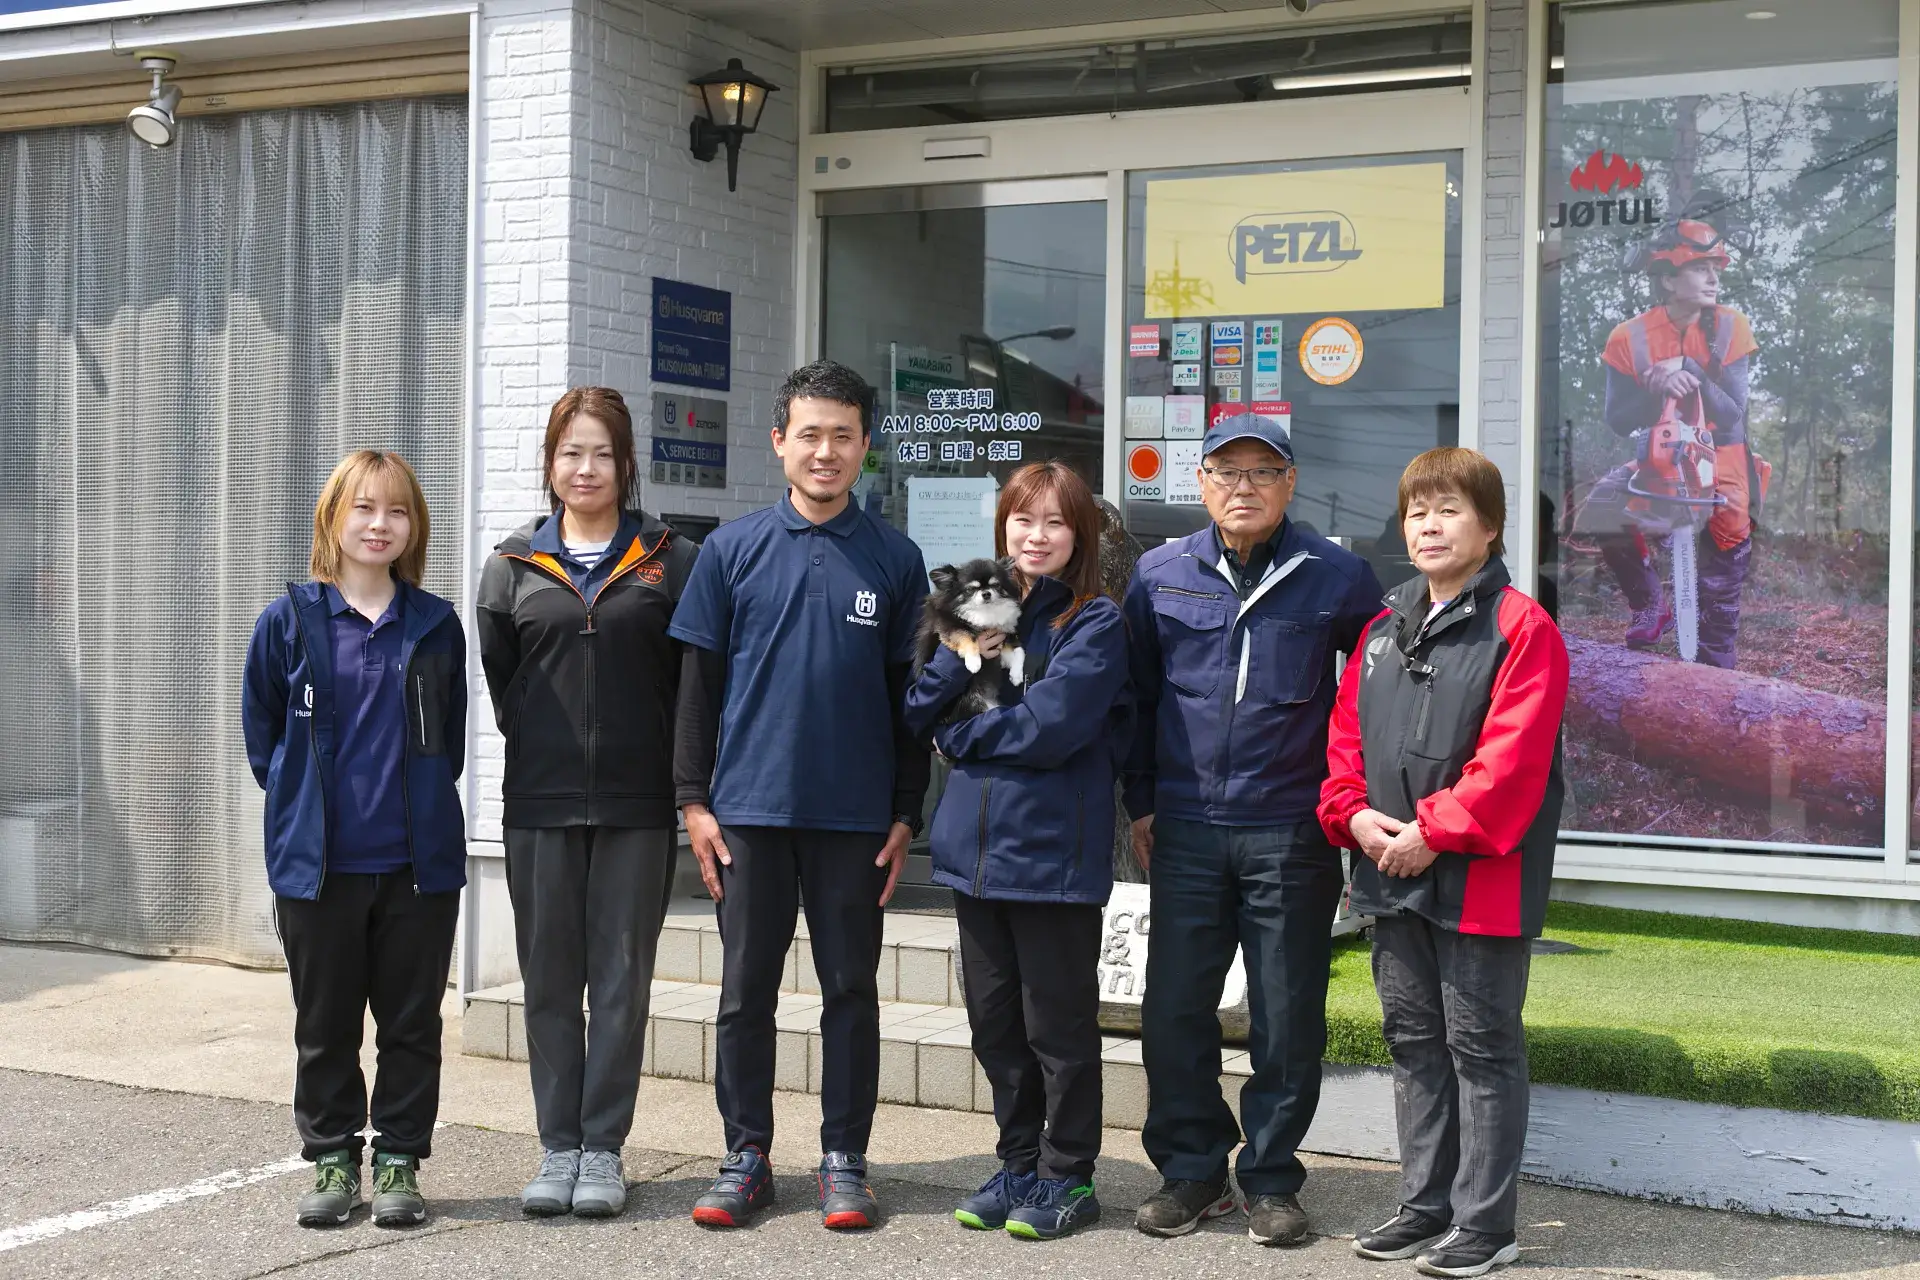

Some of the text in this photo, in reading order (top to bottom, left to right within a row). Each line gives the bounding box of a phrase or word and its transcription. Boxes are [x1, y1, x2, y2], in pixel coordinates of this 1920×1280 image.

[1550, 198, 1661, 228] JØTUL
[1235, 220, 1364, 285] PETZL
[671, 299, 724, 325] Husqvarna
[1216, 326, 1241, 337] VISA
[1311, 344, 1349, 355] STIHL
[657, 357, 703, 377] HUSQVARNA
[928, 388, 993, 410] 営業時間
[881, 415, 910, 433] AM
[1001, 412, 1042, 431] 6:00
[669, 445, 696, 459] SERVICE
[898, 440, 1022, 462] 休日 日曜・祭日
[1129, 485, 1161, 496] Orico
[636, 567, 664, 577] STIHL
